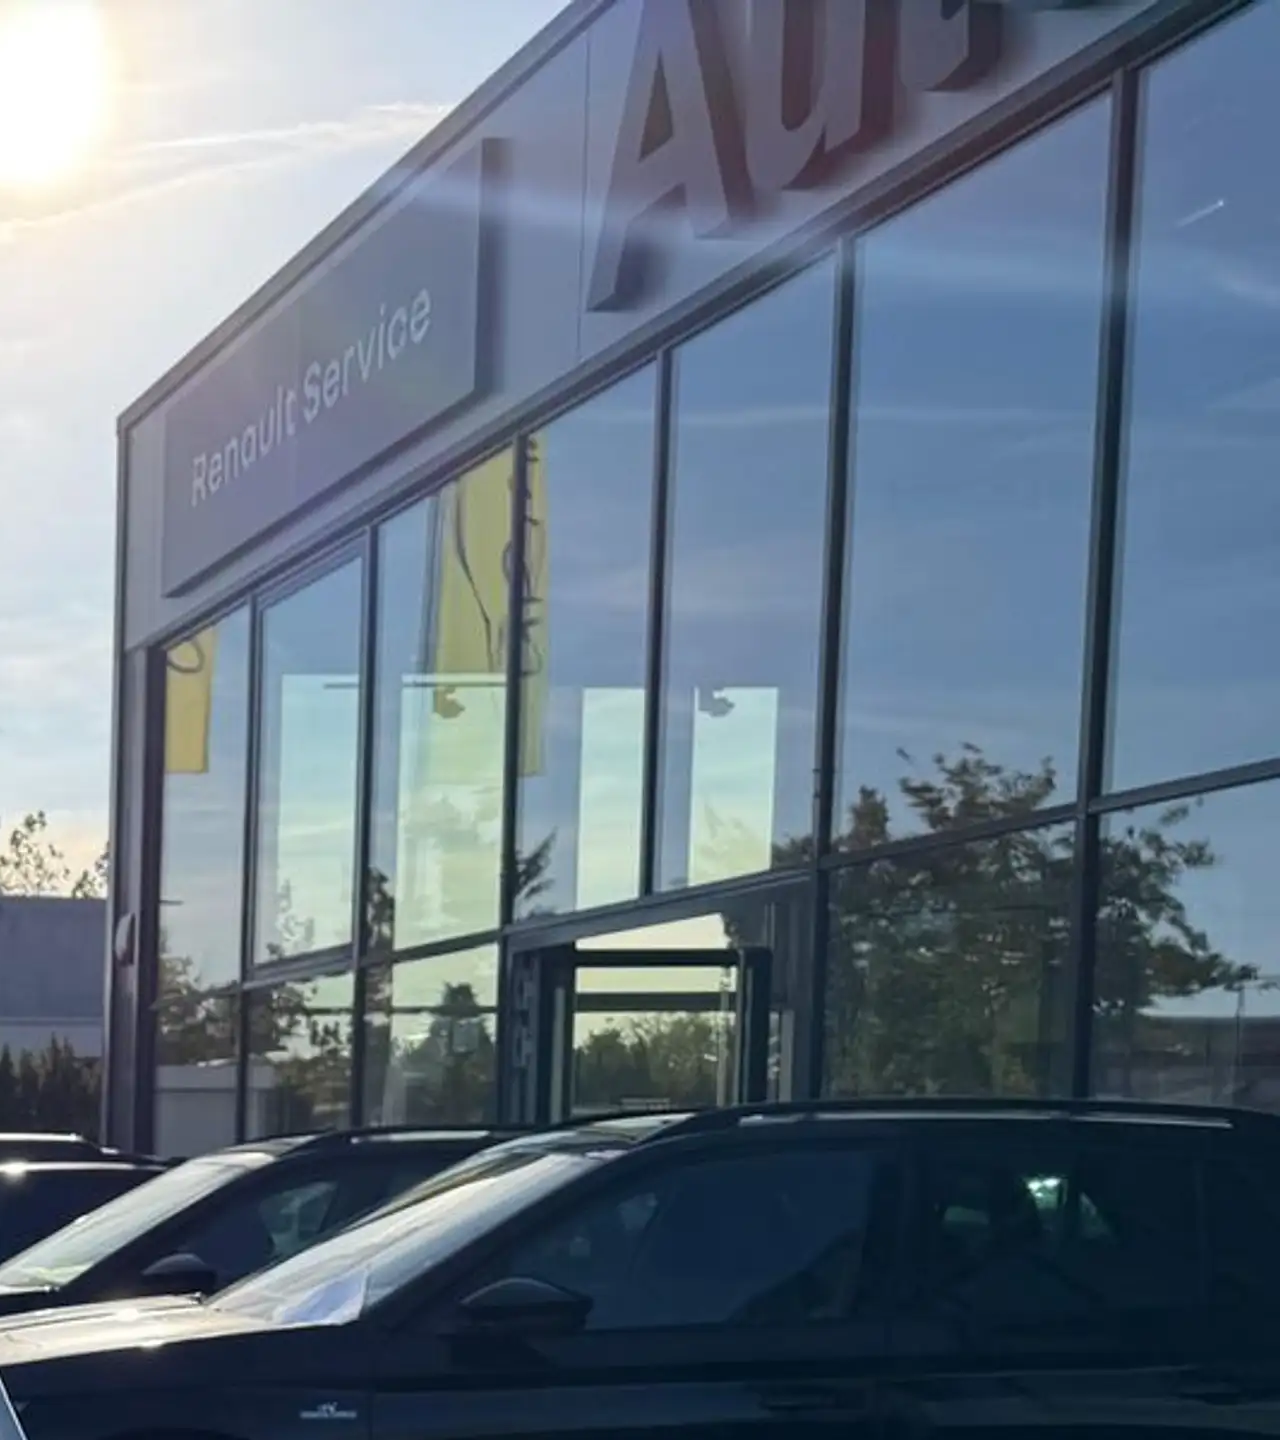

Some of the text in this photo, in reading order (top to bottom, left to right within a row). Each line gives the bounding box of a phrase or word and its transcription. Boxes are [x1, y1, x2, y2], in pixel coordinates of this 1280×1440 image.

[587, 0, 988, 312] Au
[191, 288, 432, 508] Renault Service
